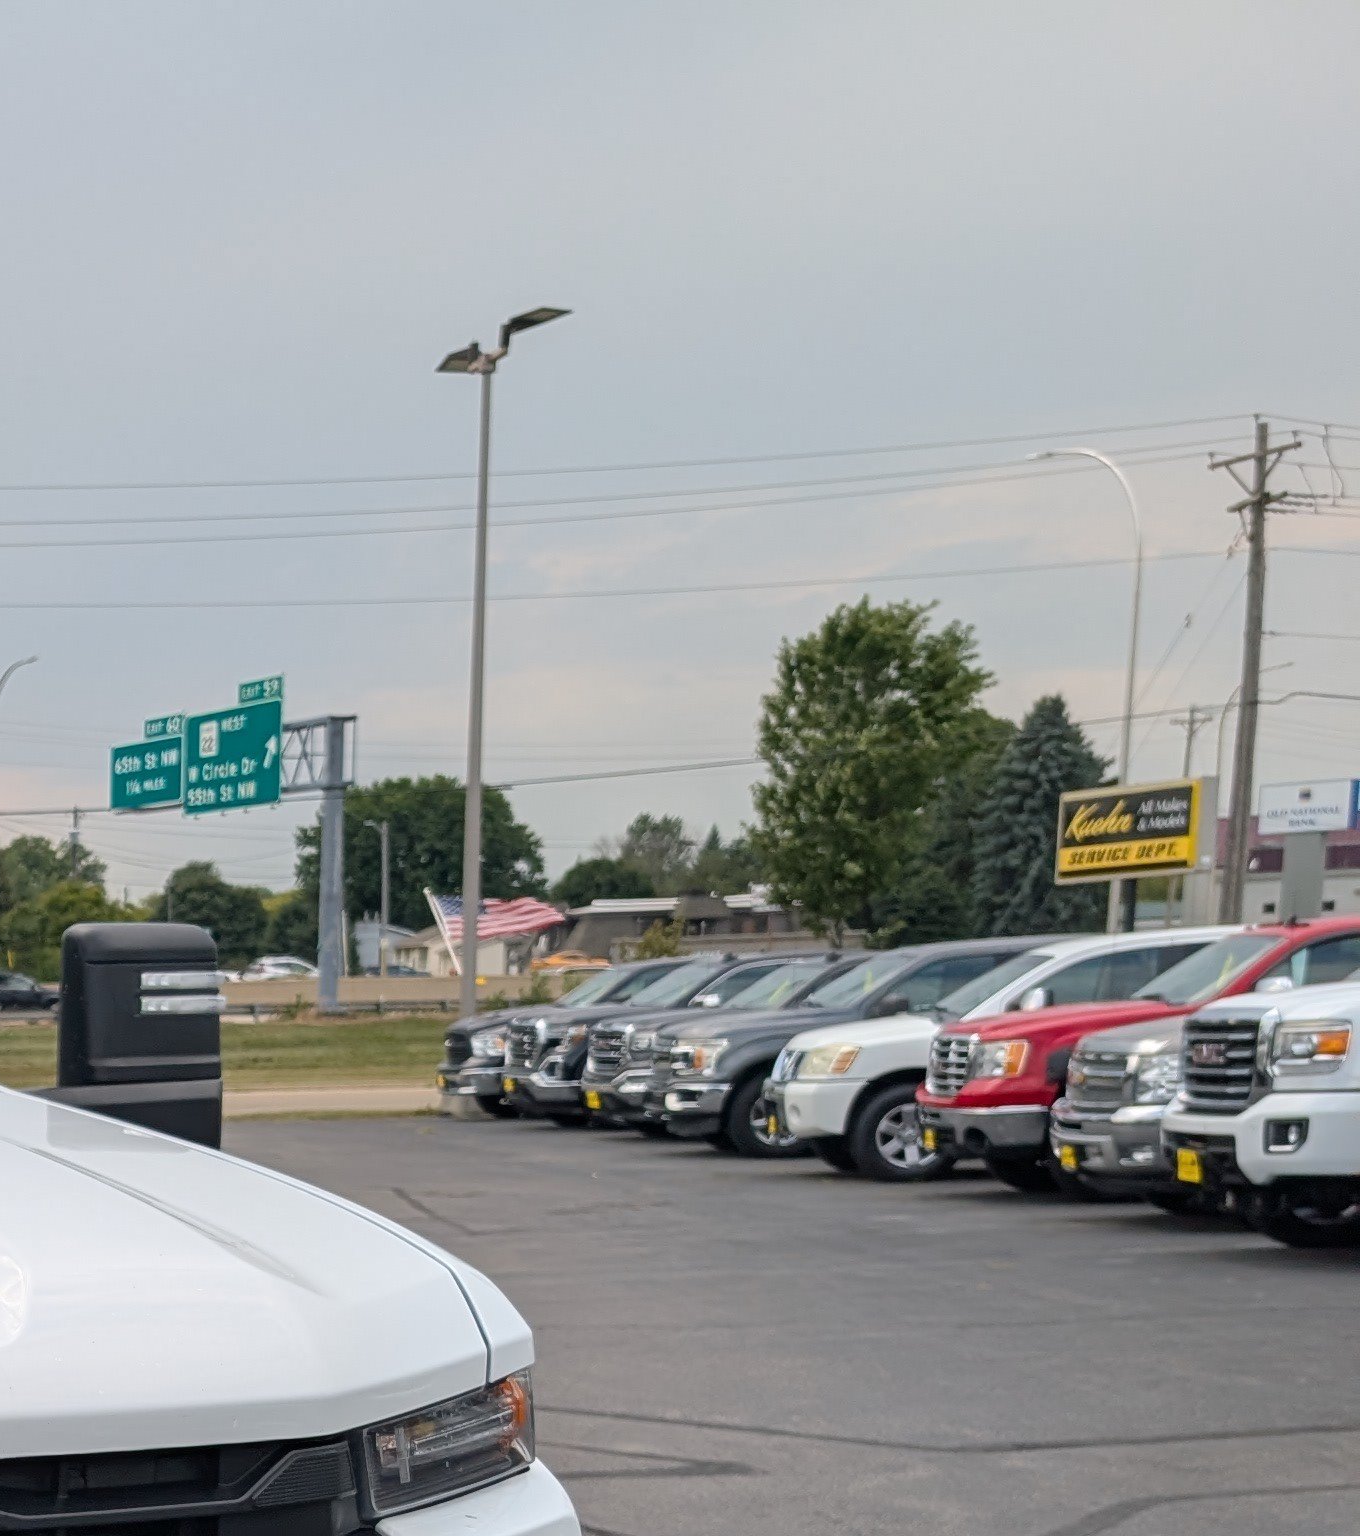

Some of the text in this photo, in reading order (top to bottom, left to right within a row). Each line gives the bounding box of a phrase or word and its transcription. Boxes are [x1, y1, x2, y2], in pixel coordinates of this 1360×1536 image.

[114, 755, 141, 775] 65th
[202, 761, 239, 781] Circle
[241, 757, 258, 776] Dr
[187, 786, 216, 806] 55th
[1064, 799, 1135, 843] Kuehn
[1068, 846, 1129, 865] SERVICE
